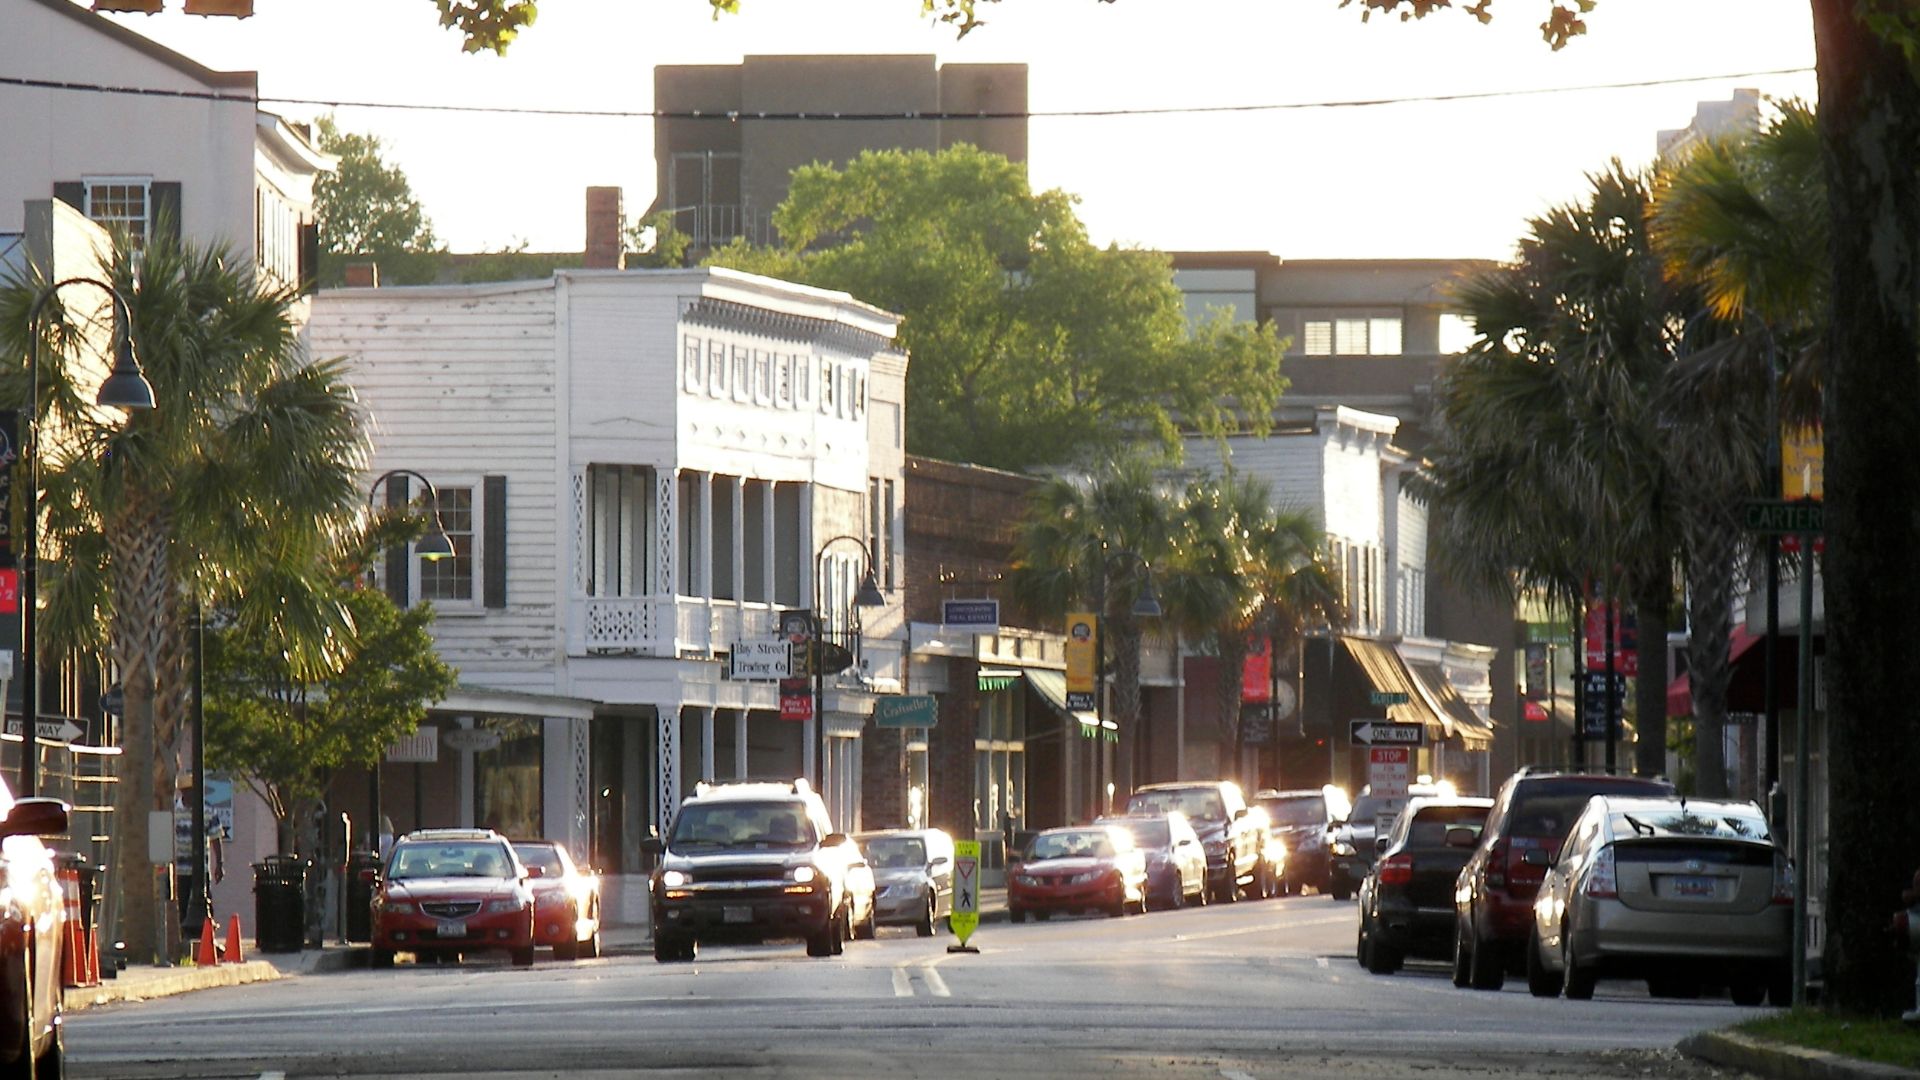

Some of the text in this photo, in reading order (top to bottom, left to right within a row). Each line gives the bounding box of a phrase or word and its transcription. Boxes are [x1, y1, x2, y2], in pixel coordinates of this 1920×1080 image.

[736, 643, 786, 656] Bay Street
[738, 660, 786, 673] Trading Co
[37, 723, 61, 737] WAY
[1372, 728, 1416, 739] ONE WAY
[1378, 751, 1401, 761] STOP
